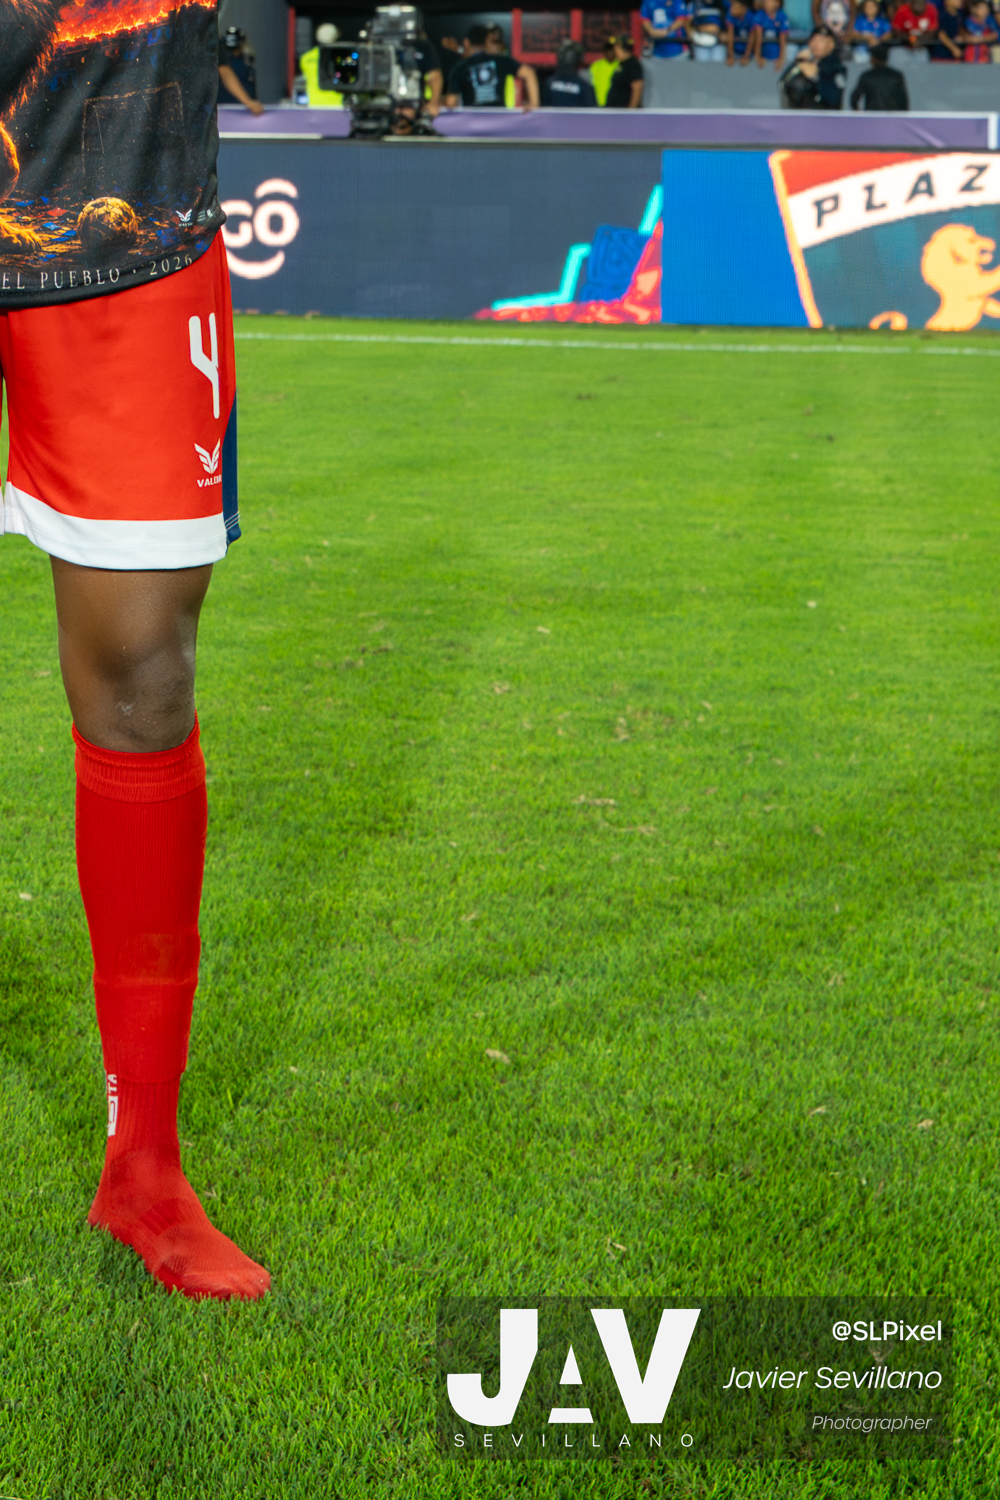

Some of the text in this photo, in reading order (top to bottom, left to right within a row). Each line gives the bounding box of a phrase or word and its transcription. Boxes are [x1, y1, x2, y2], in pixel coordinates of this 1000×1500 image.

[40, 267, 121, 289] PUEBLO
[149, 253, 193, 276] 2026
[188, 312, 220, 419] 4
